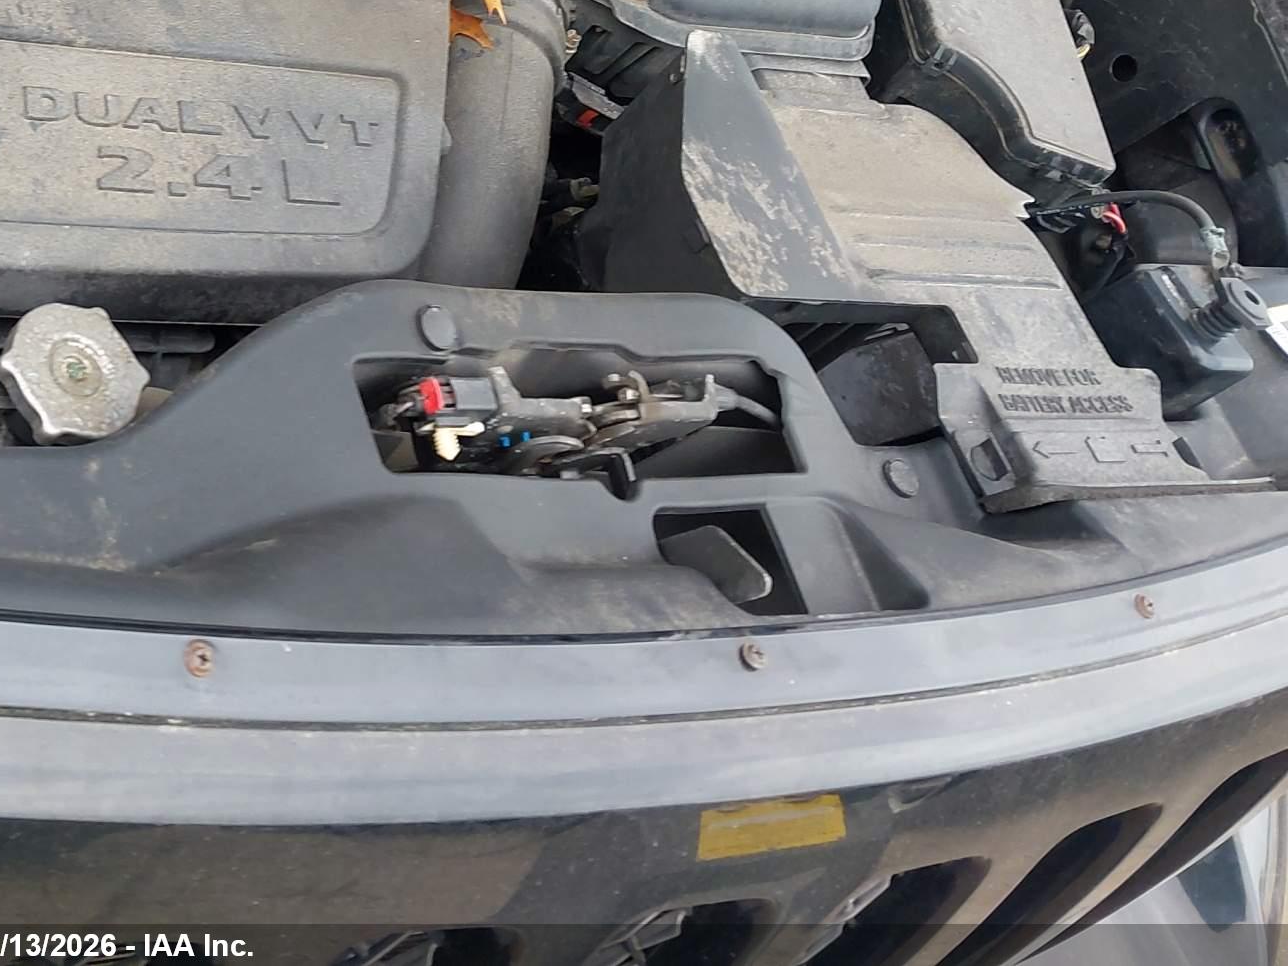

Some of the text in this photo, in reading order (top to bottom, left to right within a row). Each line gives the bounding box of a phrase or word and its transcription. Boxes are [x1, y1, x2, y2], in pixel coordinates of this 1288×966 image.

[21, 85, 380, 148] DUAL VVT
[96, 145, 342, 207] 2.4L
[995, 366, 1102, 387] REMOVE FOR
[998, 394, 1134, 414] BATTERY ACCESS
